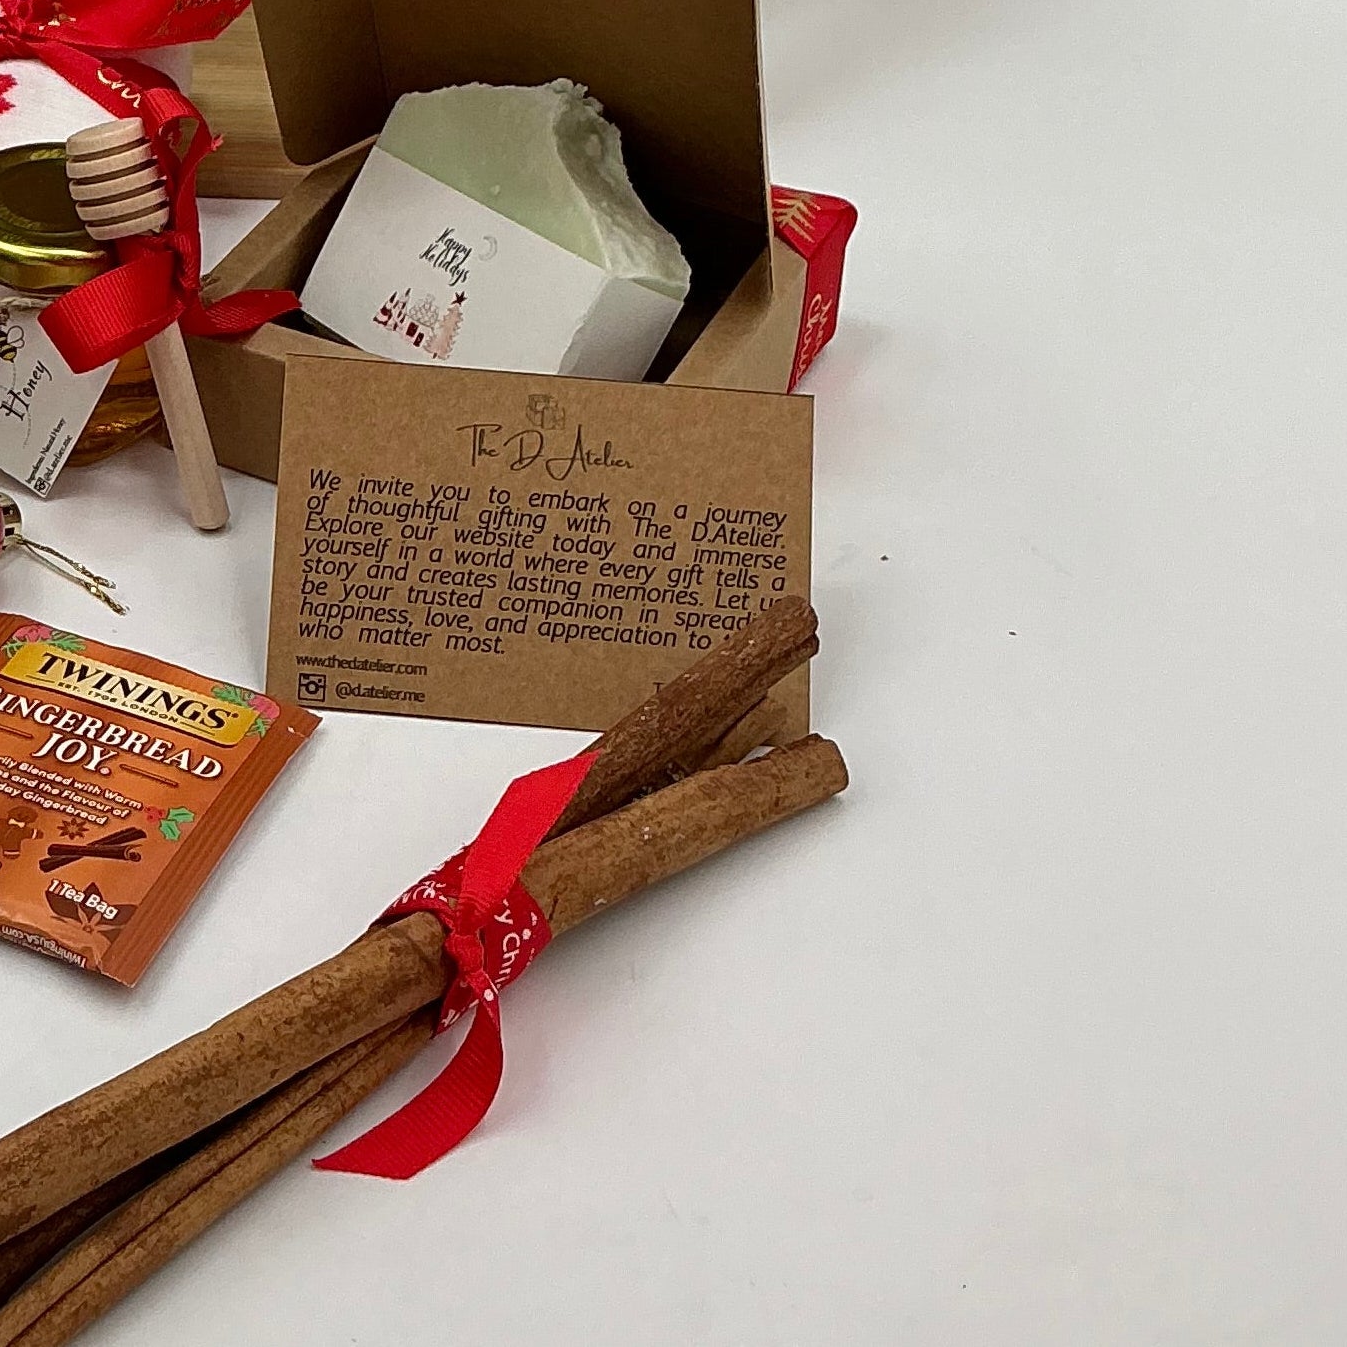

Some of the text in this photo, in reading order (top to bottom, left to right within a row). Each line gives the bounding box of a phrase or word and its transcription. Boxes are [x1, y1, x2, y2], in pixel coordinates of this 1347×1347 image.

[0, 360, 53, 422] Honey
[456, 423, 503, 467] The
[306, 491, 786, 550] of thoughtful gifting with The D.Atelier.
[310, 468, 787, 532] We invite you to embark on a journey
[300, 535, 786, 592] yourself in a world where every gift tells a
[304, 511, 787, 570] Explore our website today and immerse
[300, 574, 659, 624] be your trusted companion in
[302, 557, 751, 611] story and creates lasting memories. Let
[299, 596, 712, 650] happiness, love, and appreciation to
[299, 619, 505, 655] who matter most.
[37, 652, 233, 730] TWININGS
[11, 774, 37, 788] and
[39, 783, 60, 795] the
[61, 790, 111, 812] Flavour
[113, 808, 130, 818] of
[18, 762, 73, 786] Blended
[74, 781, 102, 795] with
[104, 789, 142, 809] Warm
[22, 791, 108, 825] Gingerbread
[48, 879, 118, 920] 1 Tea Bag
